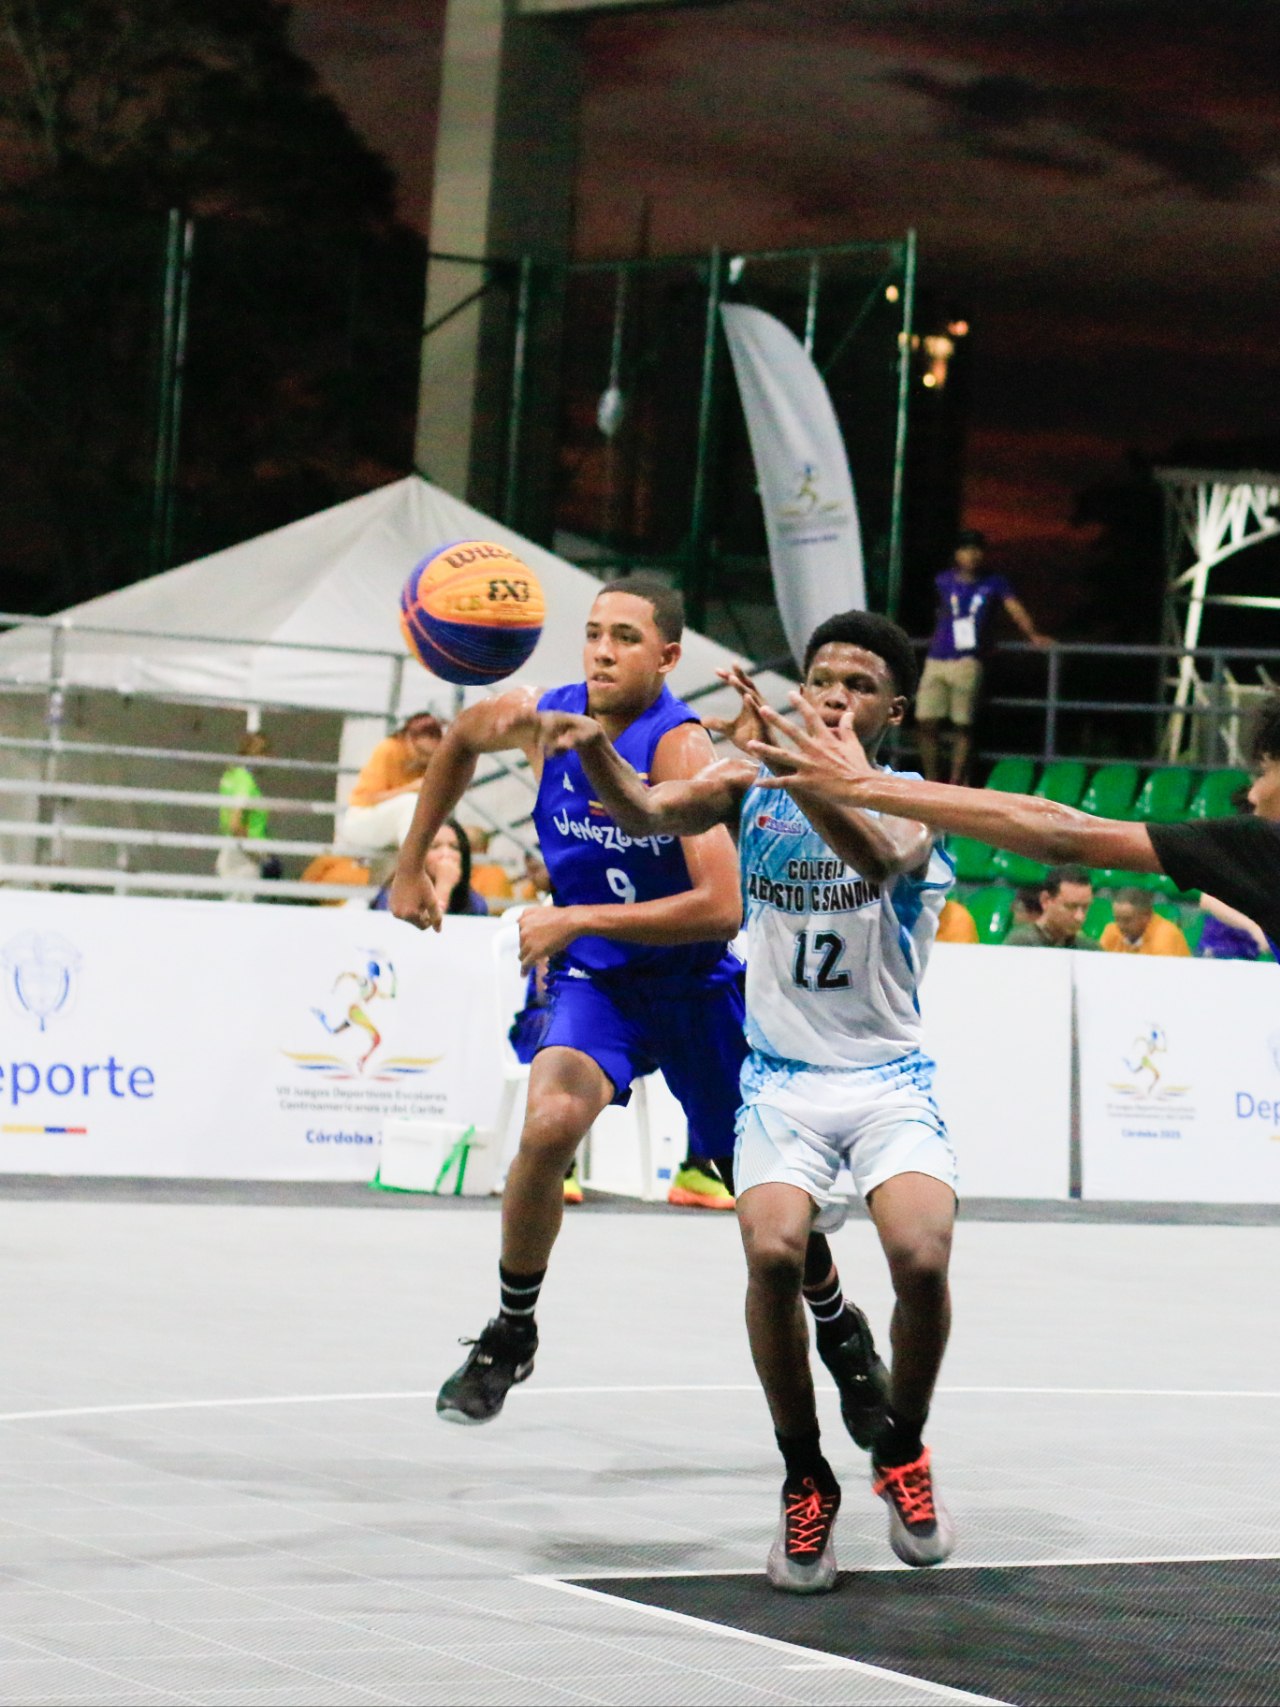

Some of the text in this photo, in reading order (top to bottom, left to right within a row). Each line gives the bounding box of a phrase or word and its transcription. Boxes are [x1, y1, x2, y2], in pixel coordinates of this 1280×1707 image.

[606, 868, 636, 904] 9
[794, 932, 851, 989] 12
[0, 1056, 156, 1106] porte
